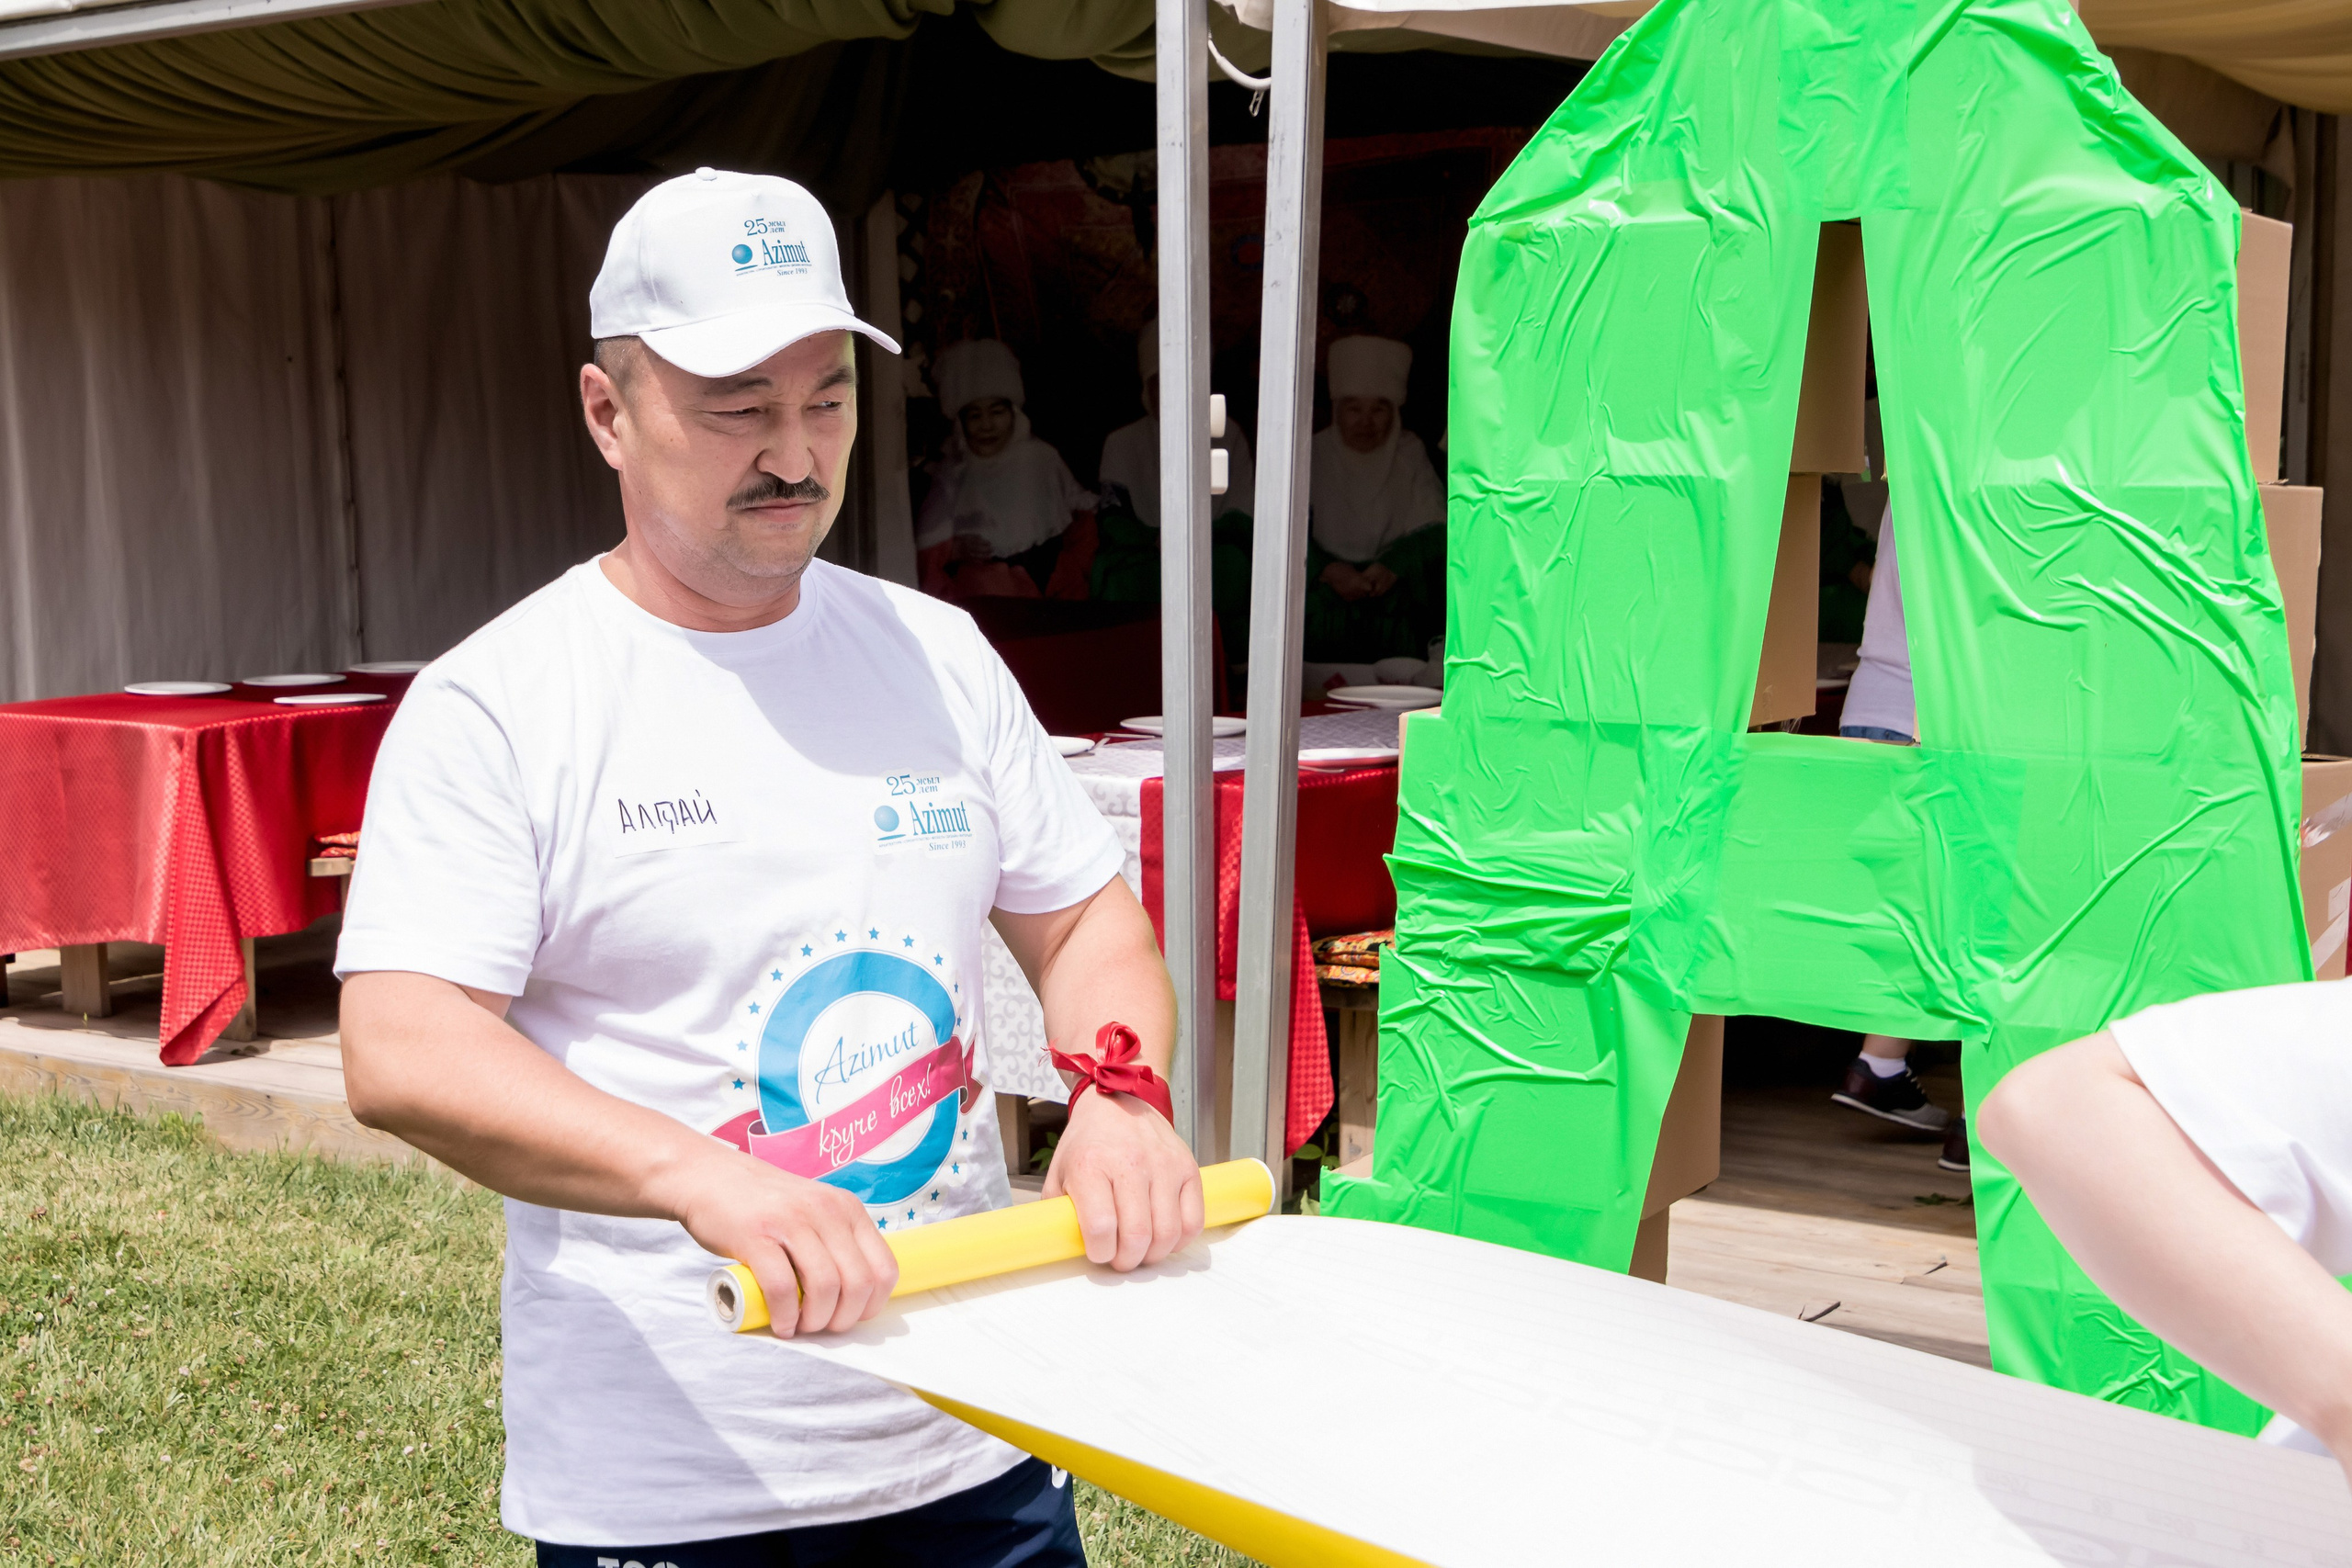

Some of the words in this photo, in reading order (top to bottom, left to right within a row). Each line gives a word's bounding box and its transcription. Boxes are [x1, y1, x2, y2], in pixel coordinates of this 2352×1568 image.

[743, 218, 768, 236] 25
[762, 238, 810, 266] Azimut
[776, 268, 794, 276] Since
[886, 773, 916, 796] 25
[916, 776, 941, 786] жыл
[919, 784, 939, 794] лет
[909, 800, 971, 836] Azimut
[928, 842, 949, 852] Since
[951, 840, 967, 850] 1993
[814, 1021, 921, 1105] Azimut
[819, 1110, 878, 1168] круче
[888, 1062, 932, 1120] всех!
